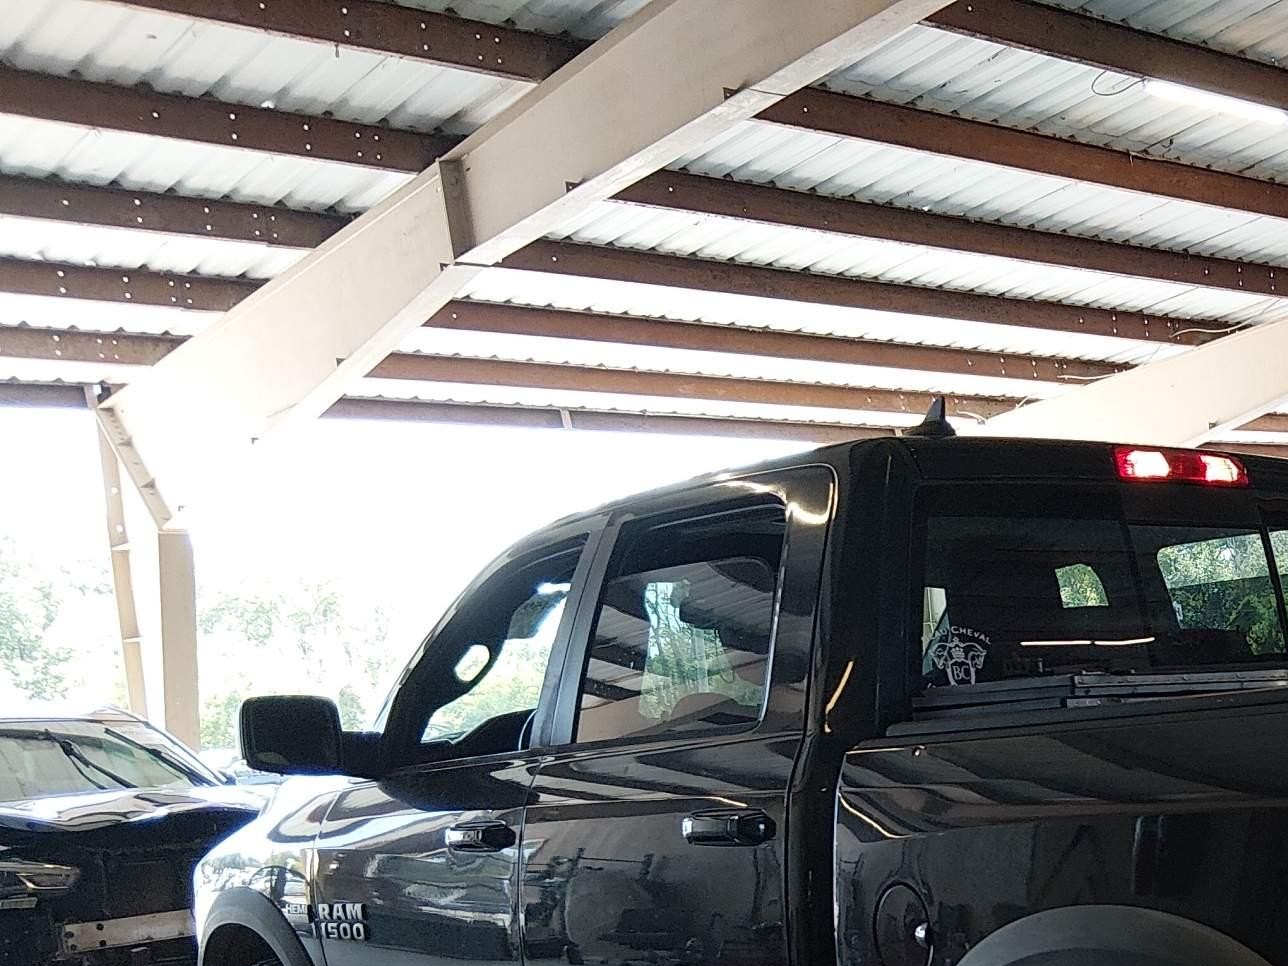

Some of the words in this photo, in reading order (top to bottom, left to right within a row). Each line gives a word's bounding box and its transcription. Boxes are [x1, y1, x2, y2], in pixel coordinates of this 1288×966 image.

[951, 625, 991, 645] CHEVAL
[952, 665, 971, 680] BC
[318, 903, 363, 920] RAM
[320, 922, 364, 939] 1500
